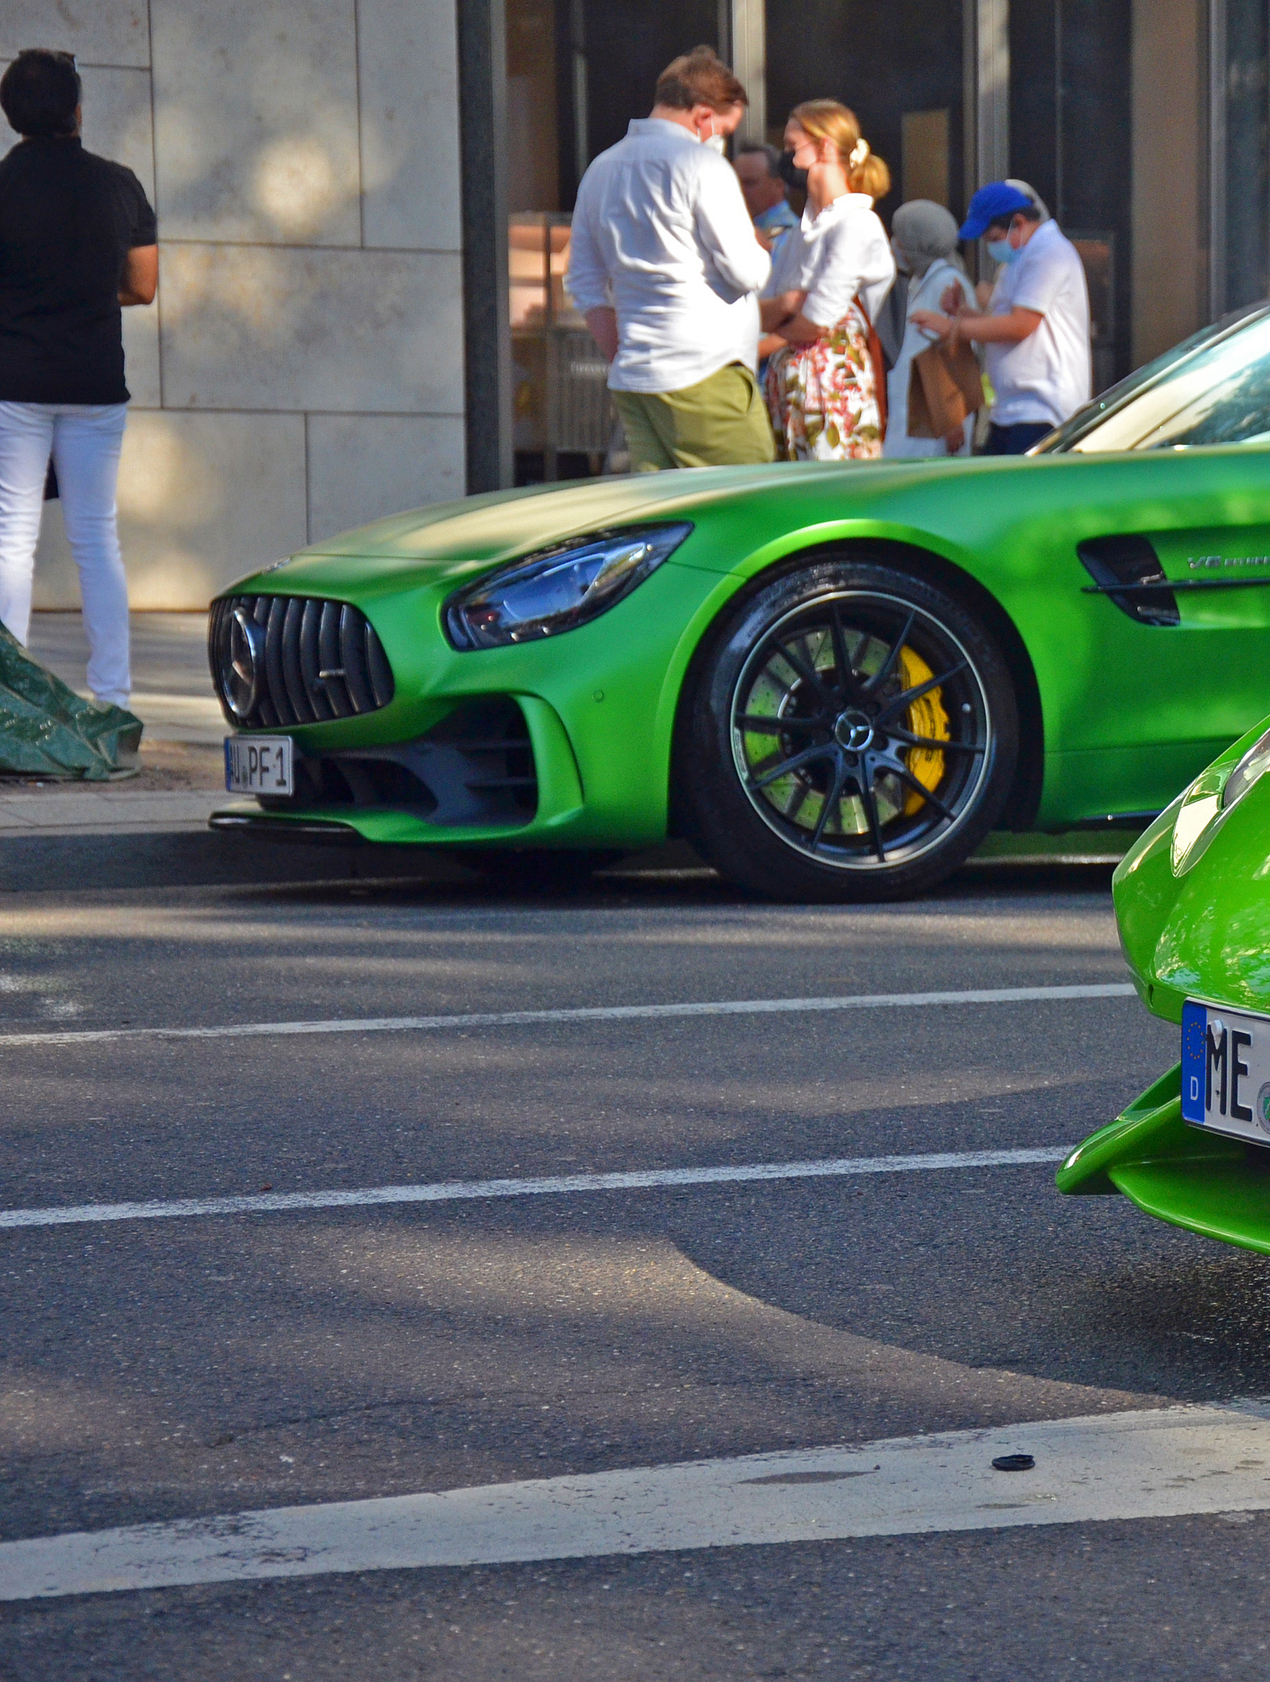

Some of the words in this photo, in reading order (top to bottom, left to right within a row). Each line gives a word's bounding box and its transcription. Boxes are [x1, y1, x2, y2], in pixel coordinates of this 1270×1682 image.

[248, 746, 271, 786] PF
[275, 746, 287, 787] 1
[1190, 1075, 1199, 1101] D
[1205, 1021, 1253, 1122] ME
